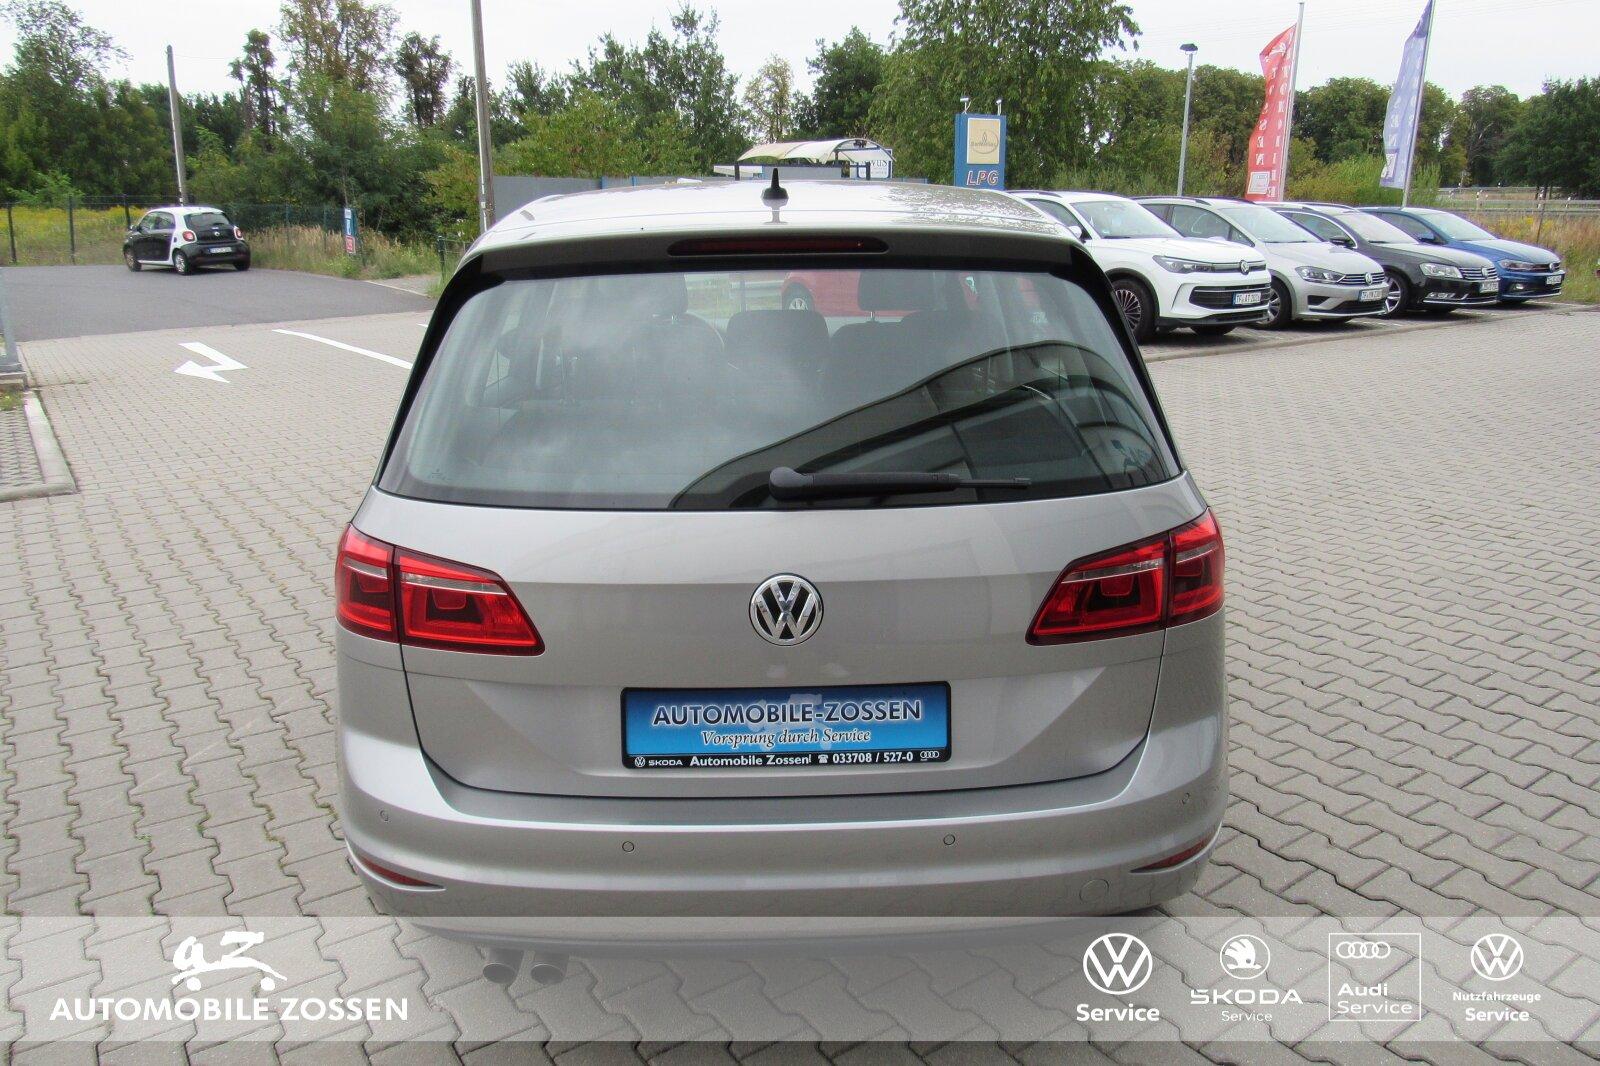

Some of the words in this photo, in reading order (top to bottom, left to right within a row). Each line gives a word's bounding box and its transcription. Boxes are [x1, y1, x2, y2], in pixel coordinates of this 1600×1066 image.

[966, 170, 998, 186] LPG
[652, 699, 922, 727] AUTOMOBILE-ZOSSEN
[702, 729, 775, 748] Vorsprung
[777, 730, 818, 744] durch
[822, 728, 871, 743] Service
[690, 755, 763, 767] Automobile
[832, 753, 873, 764] 033708
[883, 751, 914, 762] 527-0
